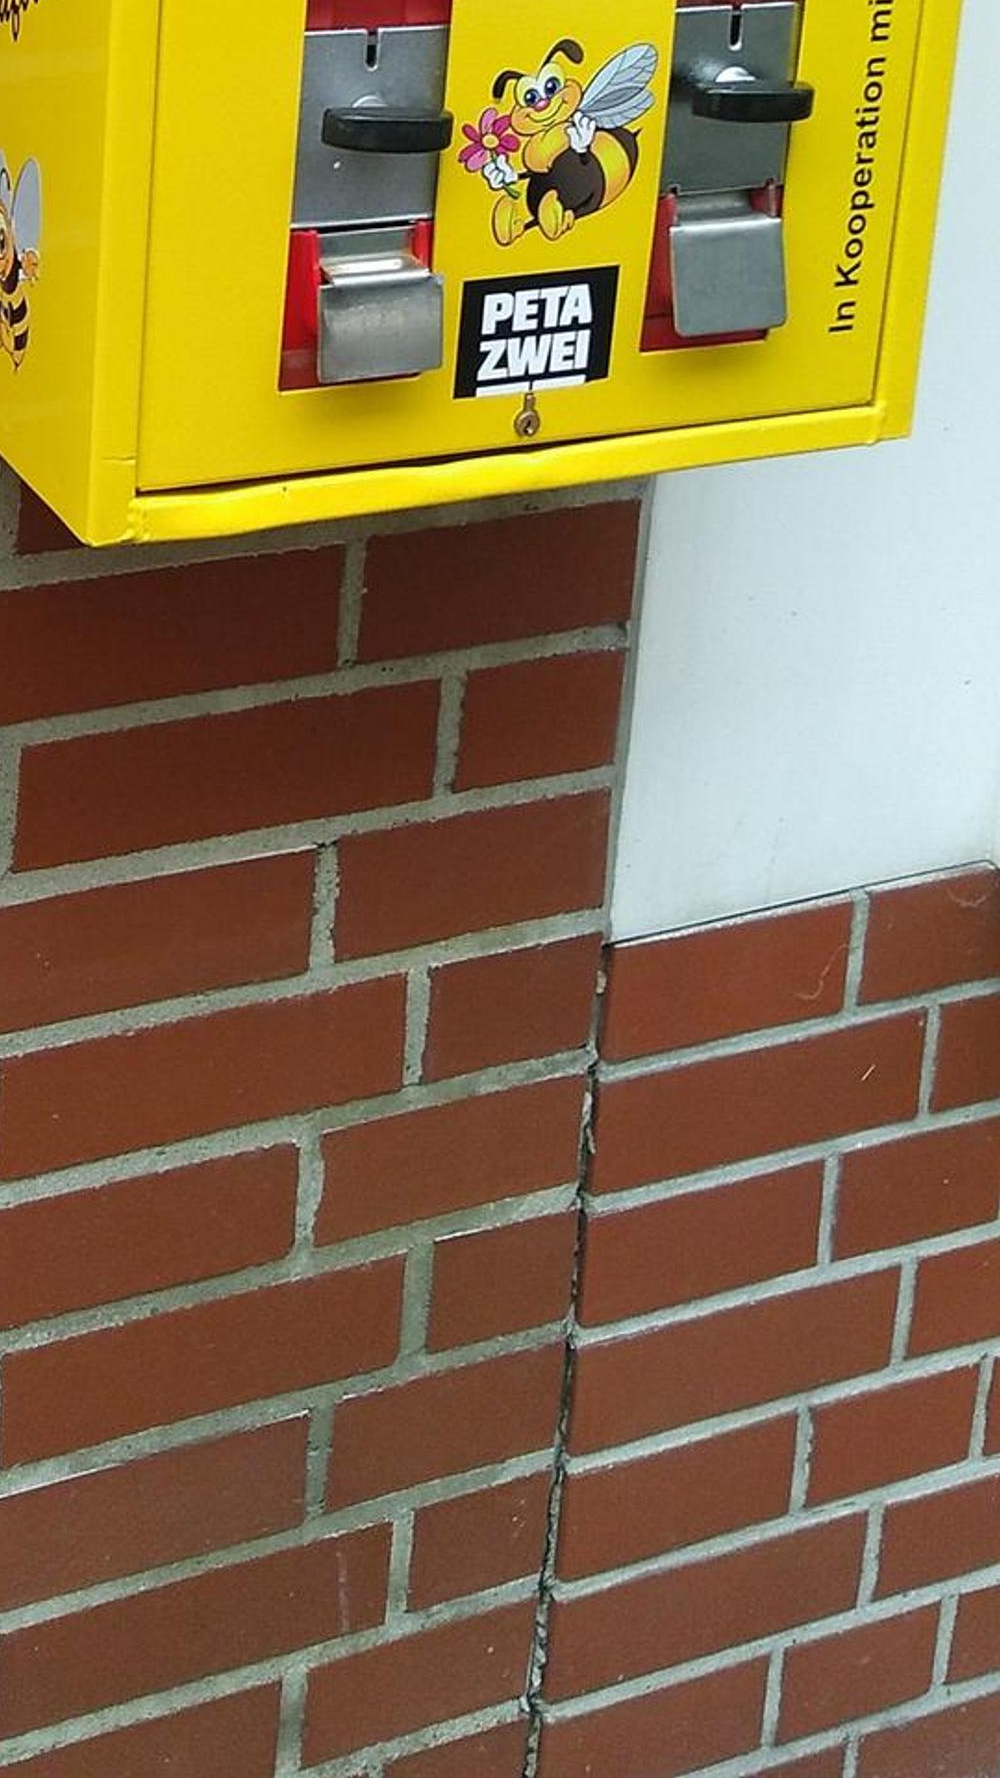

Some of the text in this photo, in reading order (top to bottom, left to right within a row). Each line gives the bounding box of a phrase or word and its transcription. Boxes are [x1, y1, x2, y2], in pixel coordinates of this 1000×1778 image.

[834, 57, 886, 288] Kooperation
[481, 283, 593, 335] PETA
[828, 300, 856, 333] In
[477, 329, 591, 381] ZWEI
